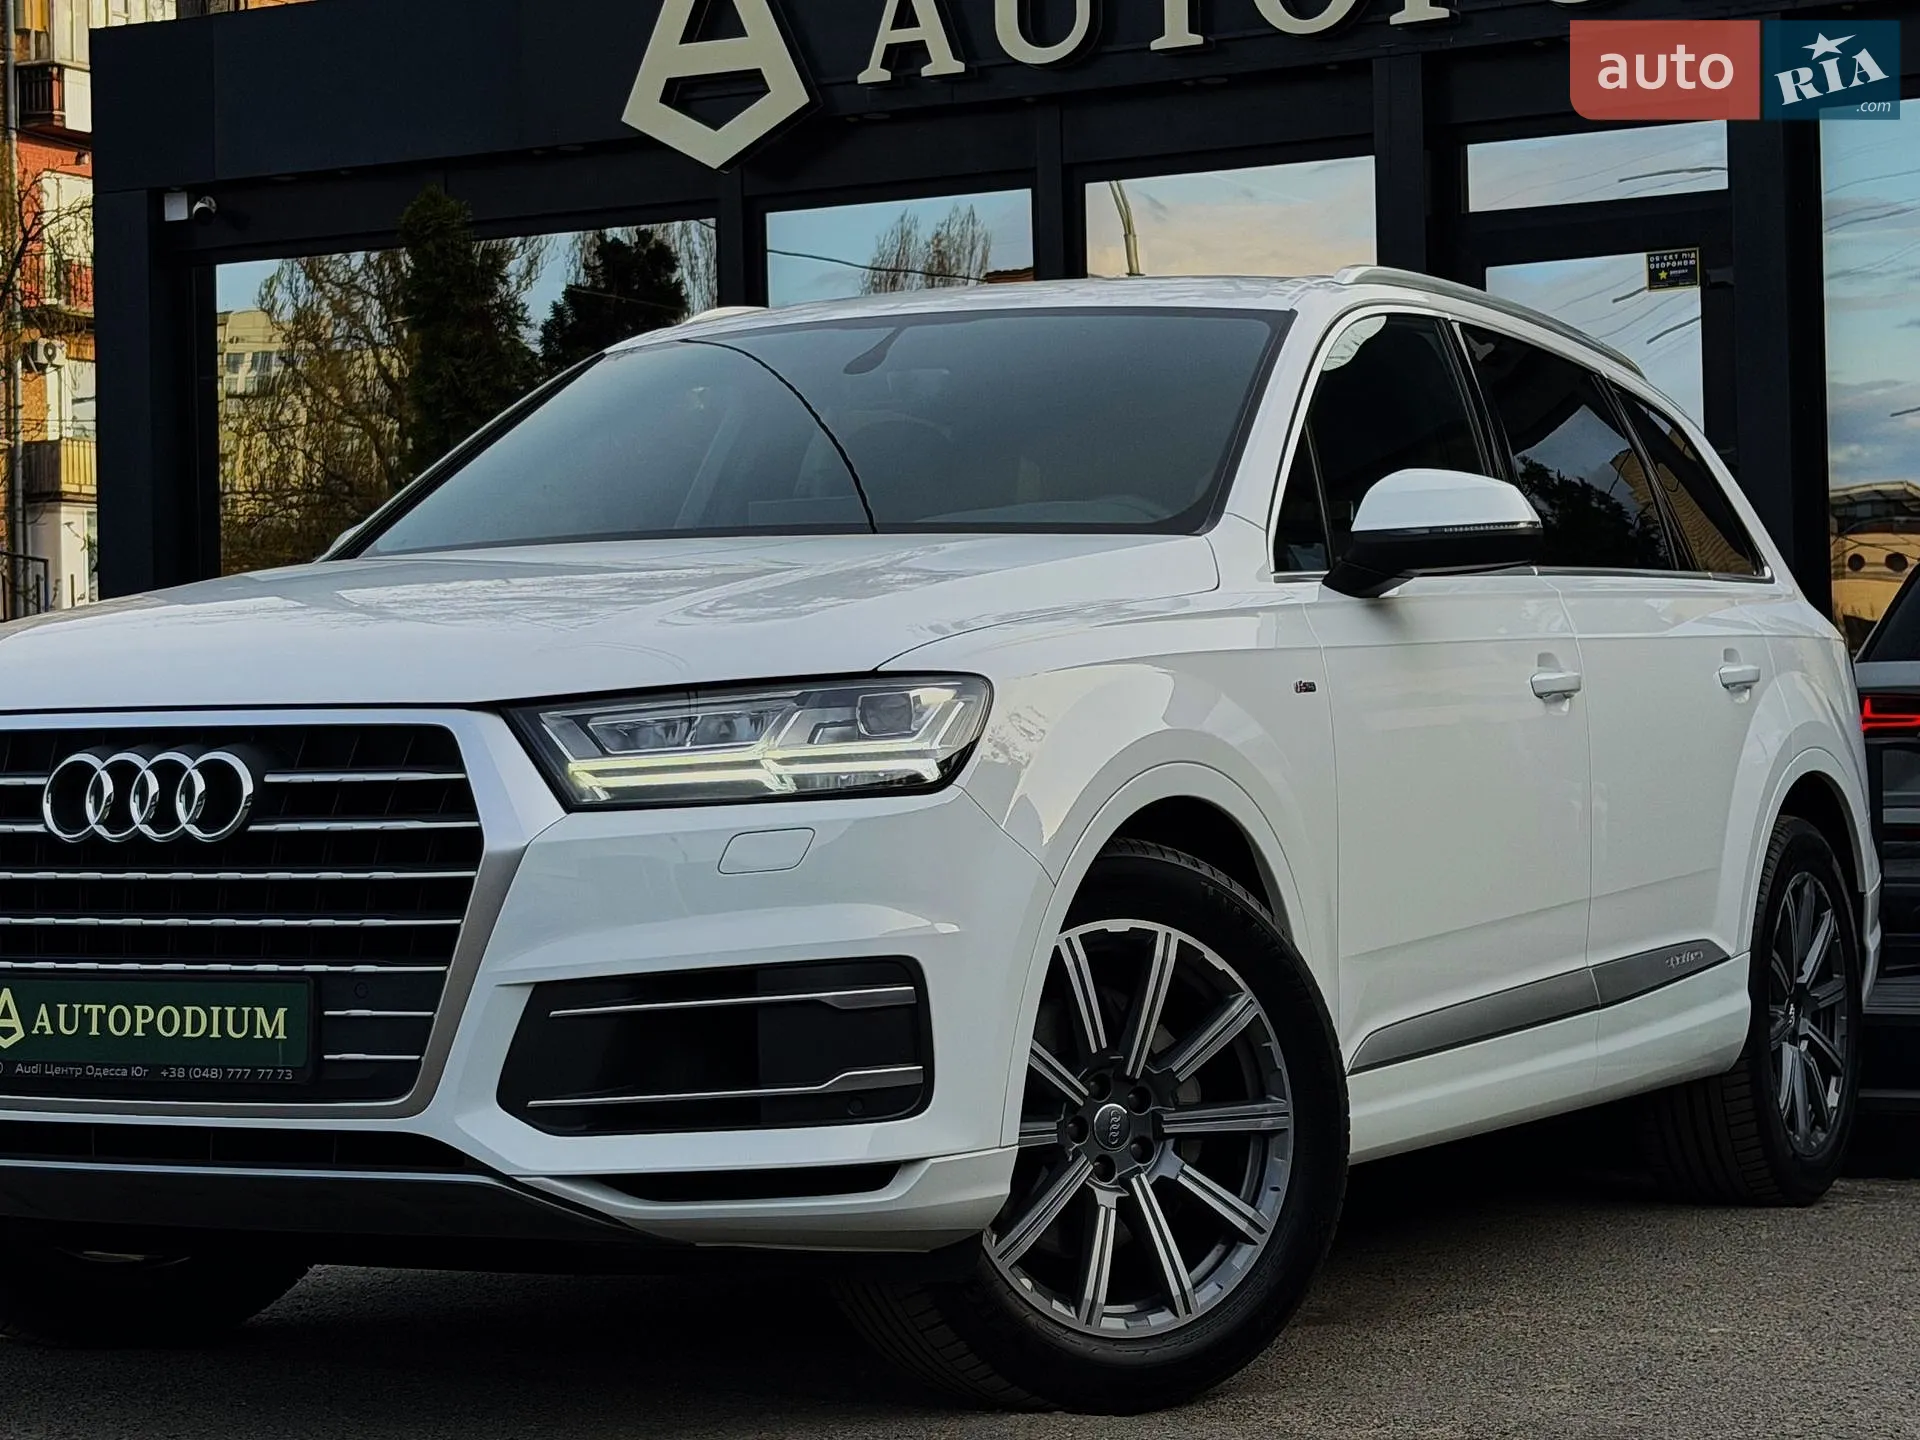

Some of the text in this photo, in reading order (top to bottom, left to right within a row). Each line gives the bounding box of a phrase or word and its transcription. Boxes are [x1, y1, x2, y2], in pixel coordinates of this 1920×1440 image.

[31, 1003, 288, 1040] AUTOPODIUM
[15, 1063, 293, 1080] Audi Центр Одесса Юг +38 (048) 777 77 73
